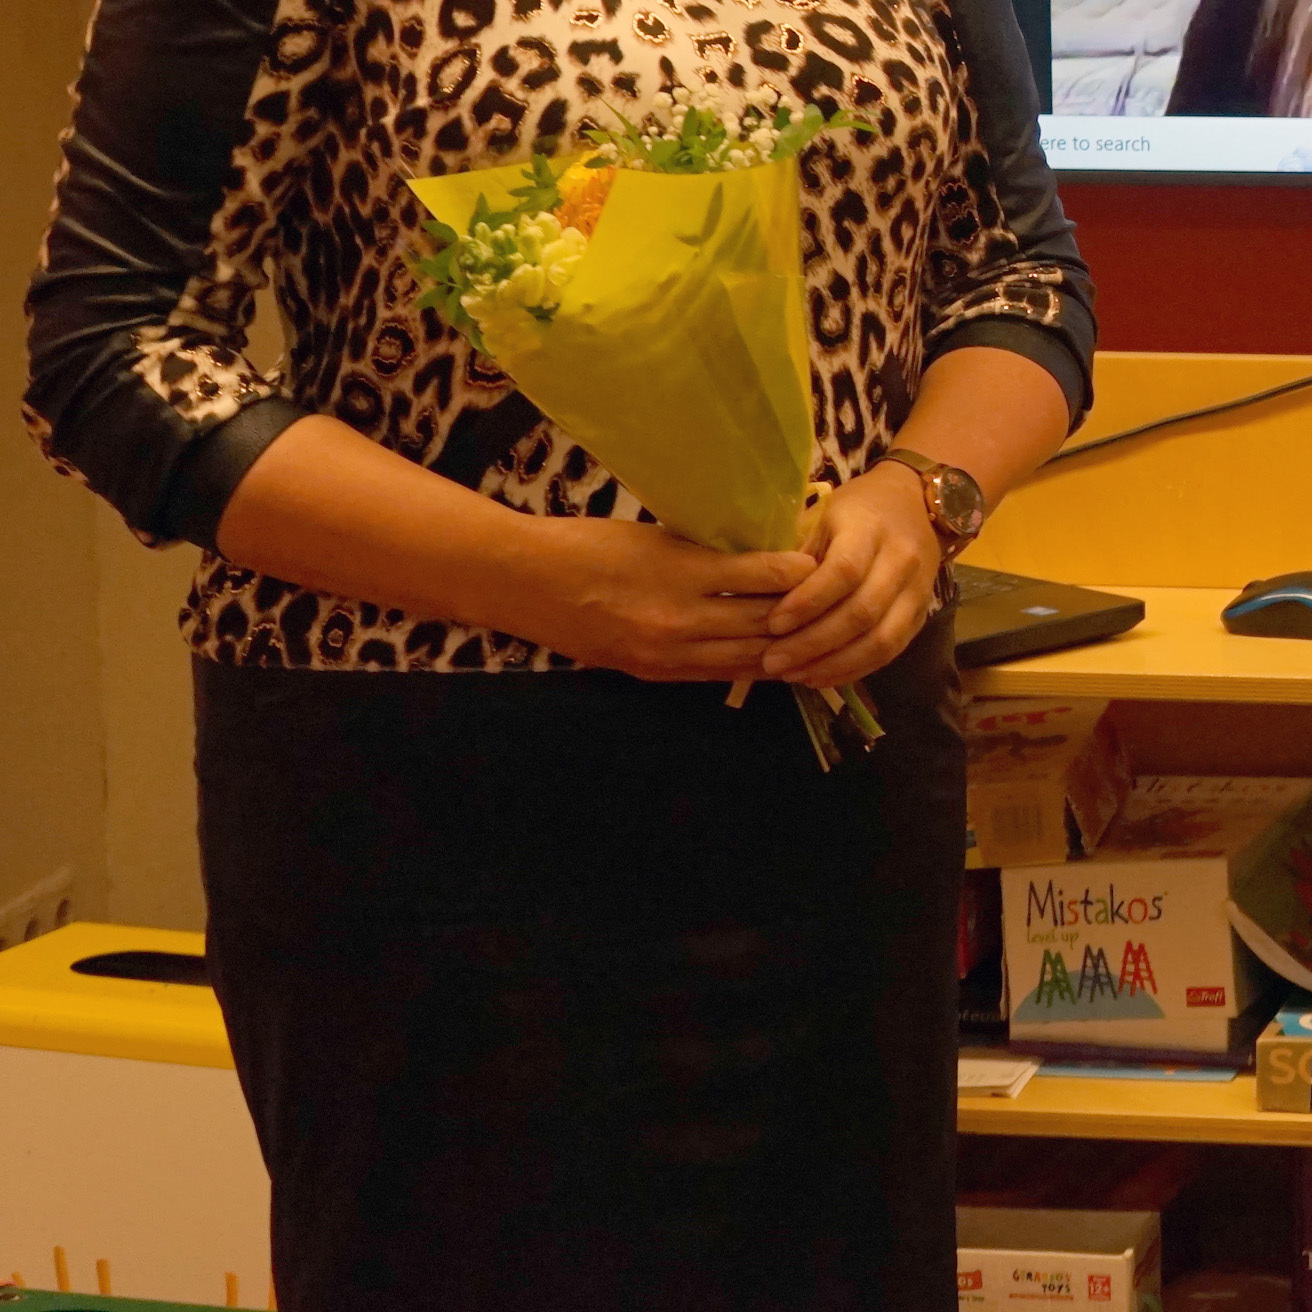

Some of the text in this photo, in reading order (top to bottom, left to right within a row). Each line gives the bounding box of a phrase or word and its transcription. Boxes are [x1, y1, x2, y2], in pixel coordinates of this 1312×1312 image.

[1040, 136, 1151, 151] ere to search
[1026, 879, 1164, 928] Mistakos
